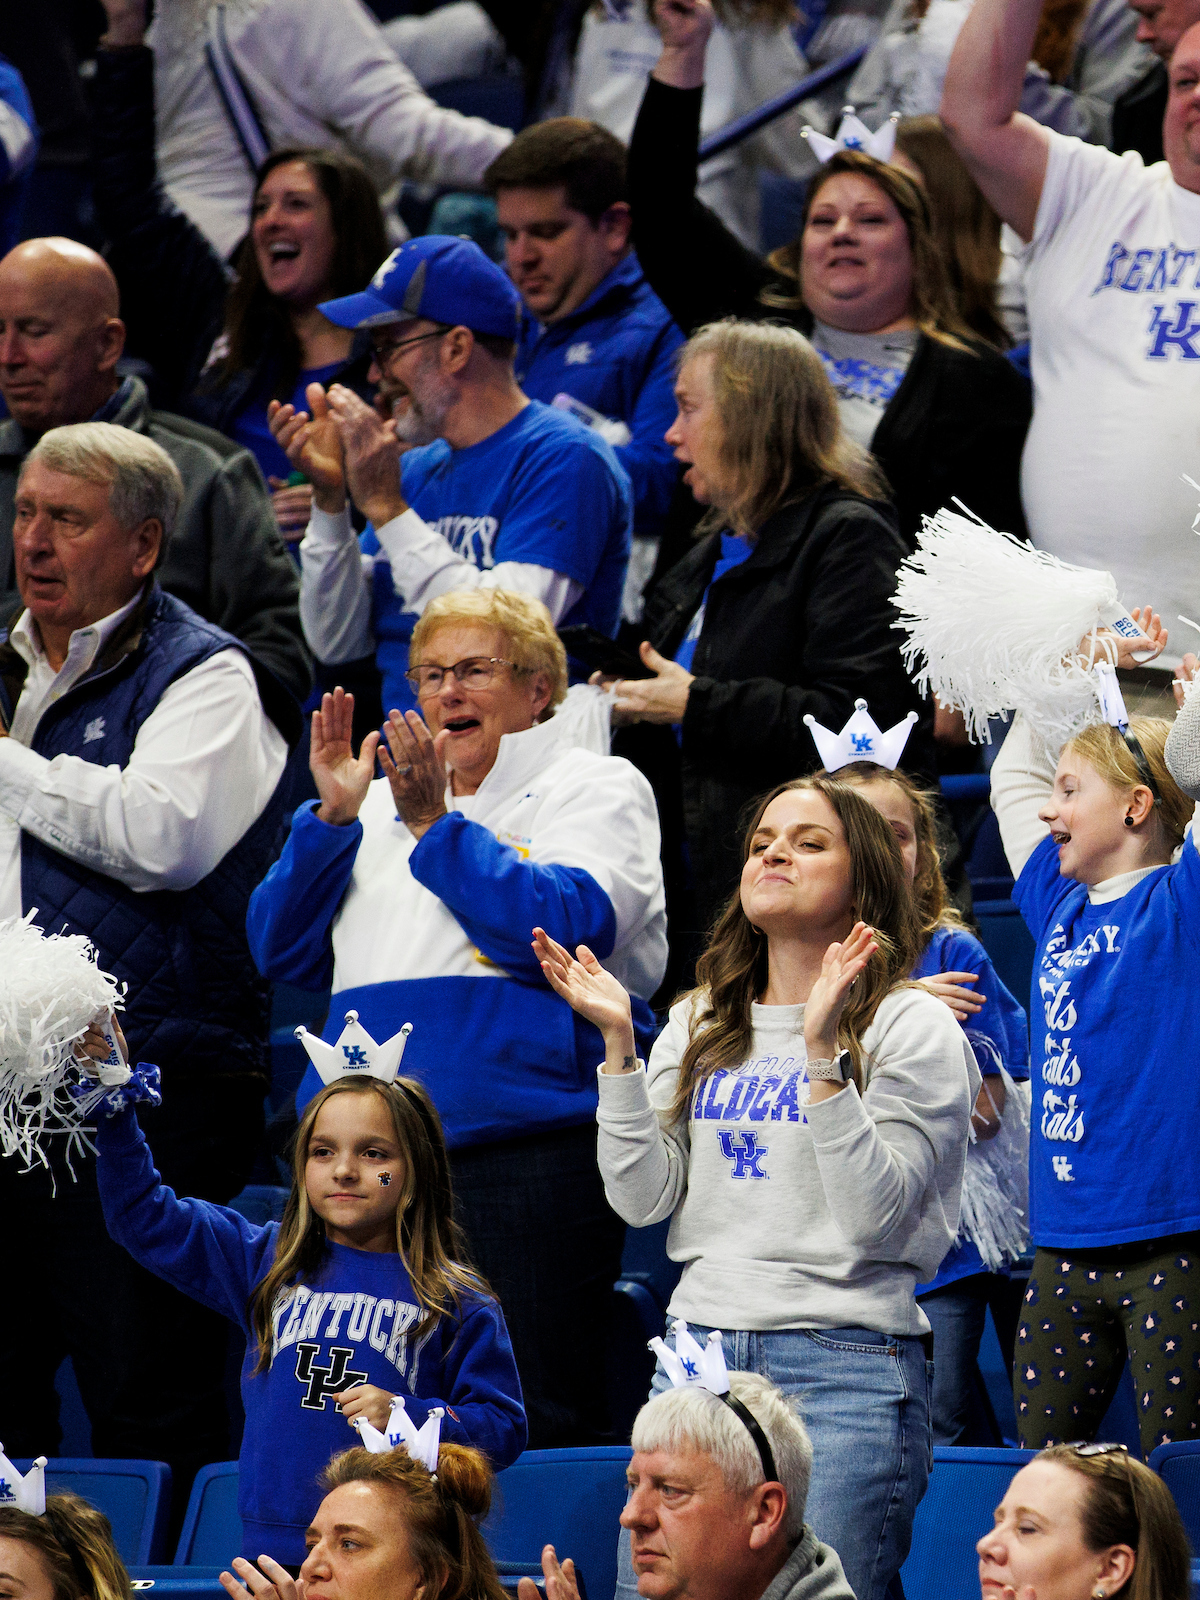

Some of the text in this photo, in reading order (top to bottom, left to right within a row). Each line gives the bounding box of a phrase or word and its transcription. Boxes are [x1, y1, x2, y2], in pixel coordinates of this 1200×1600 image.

[1115, 620, 1135, 638] BLU
[850, 733, 873, 752] UK
[342, 1045, 367, 1065] UK
[717, 1129, 769, 1180] UK
[295, 1342, 368, 1413] UK
